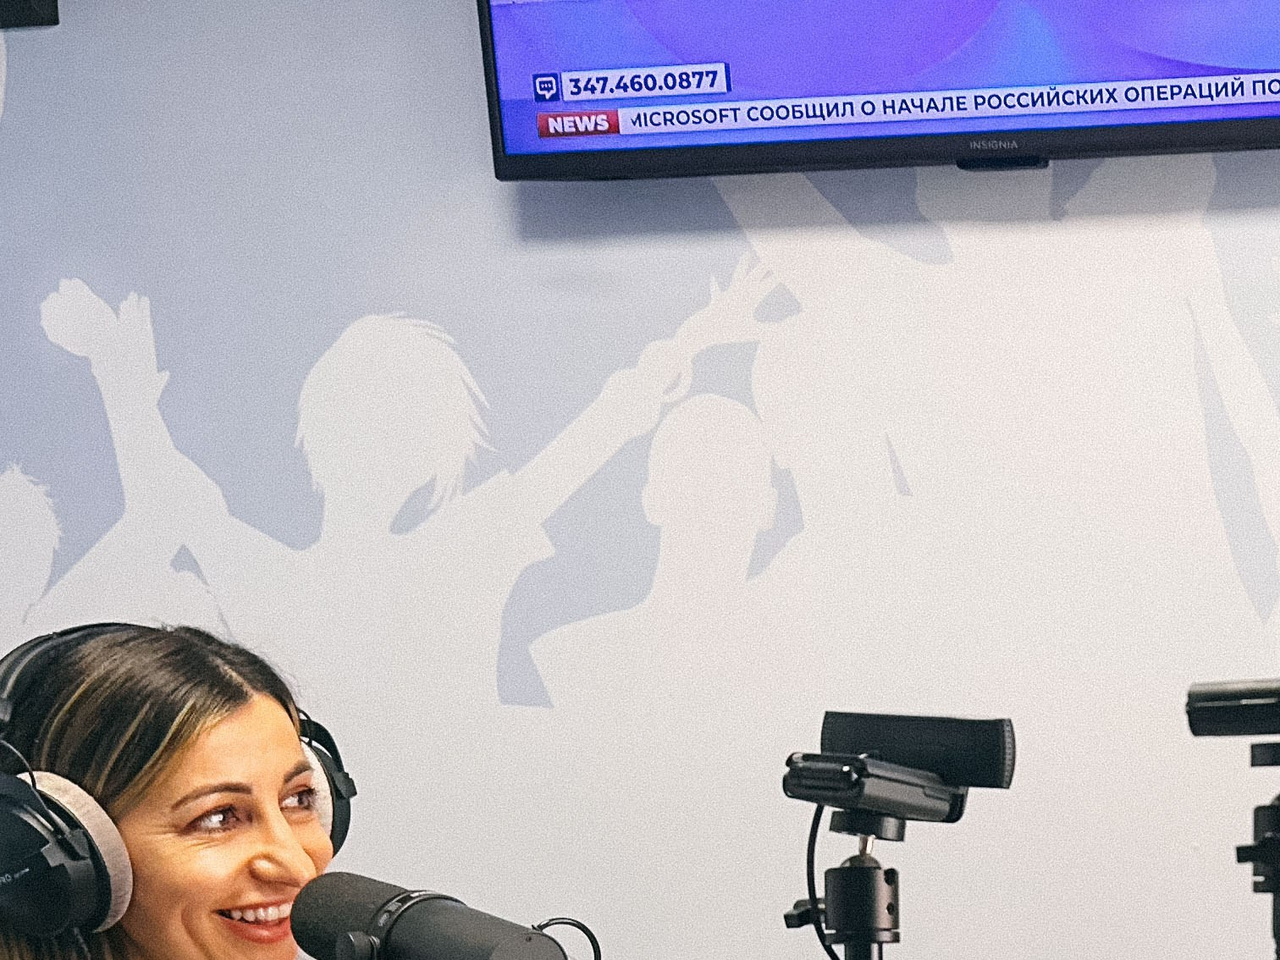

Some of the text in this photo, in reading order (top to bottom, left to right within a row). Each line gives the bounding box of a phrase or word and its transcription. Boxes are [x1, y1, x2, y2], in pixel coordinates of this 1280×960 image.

[568, 70, 718, 96] 347.460.0877
[746, 100, 855, 123] СООБЩИЛ
[861, 99, 876, 117] О
[882, 95, 968, 116] НАЧАЛЕ
[973, 85, 1118, 110] РОССИЙСКИХ
[1124, 77, 1245, 103] ОПЕРАЦИЙ
[547, 114, 610, 134] NEWS
